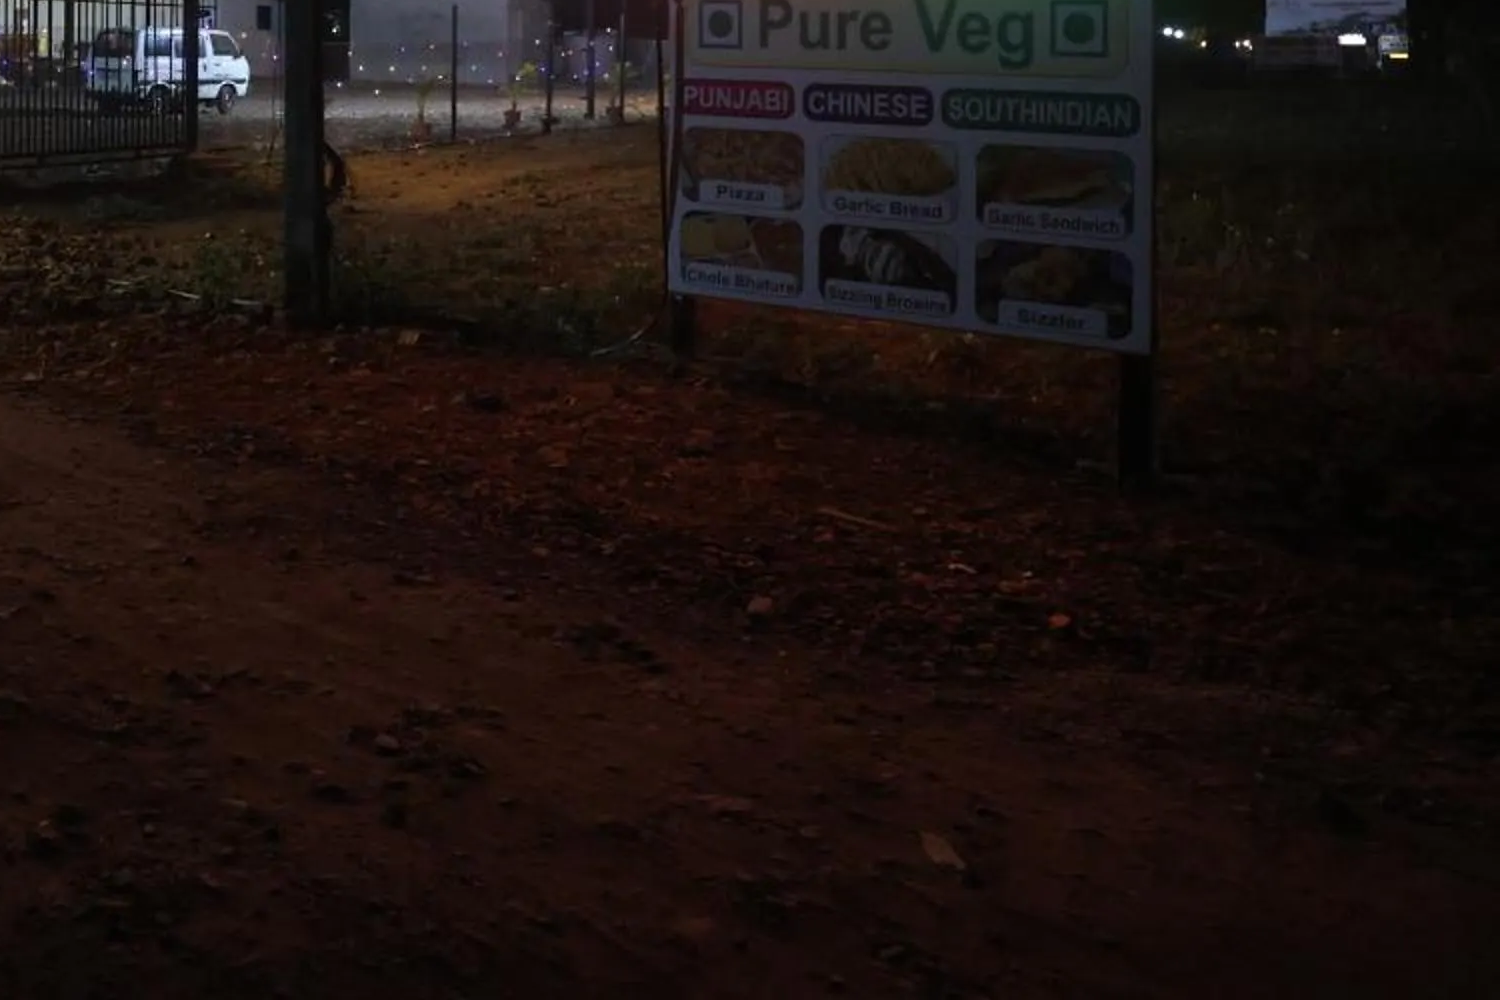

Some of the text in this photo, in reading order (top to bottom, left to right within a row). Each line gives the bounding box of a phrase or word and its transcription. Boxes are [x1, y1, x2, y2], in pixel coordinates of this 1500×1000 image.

[683, 84, 789, 112] PUNJABI
[808, 90, 928, 120] CHINESE
[948, 97, 1133, 129] SOUTHINDIAN
[716, 185, 766, 202] Pizza
[835, 196, 885, 214] Garlic
